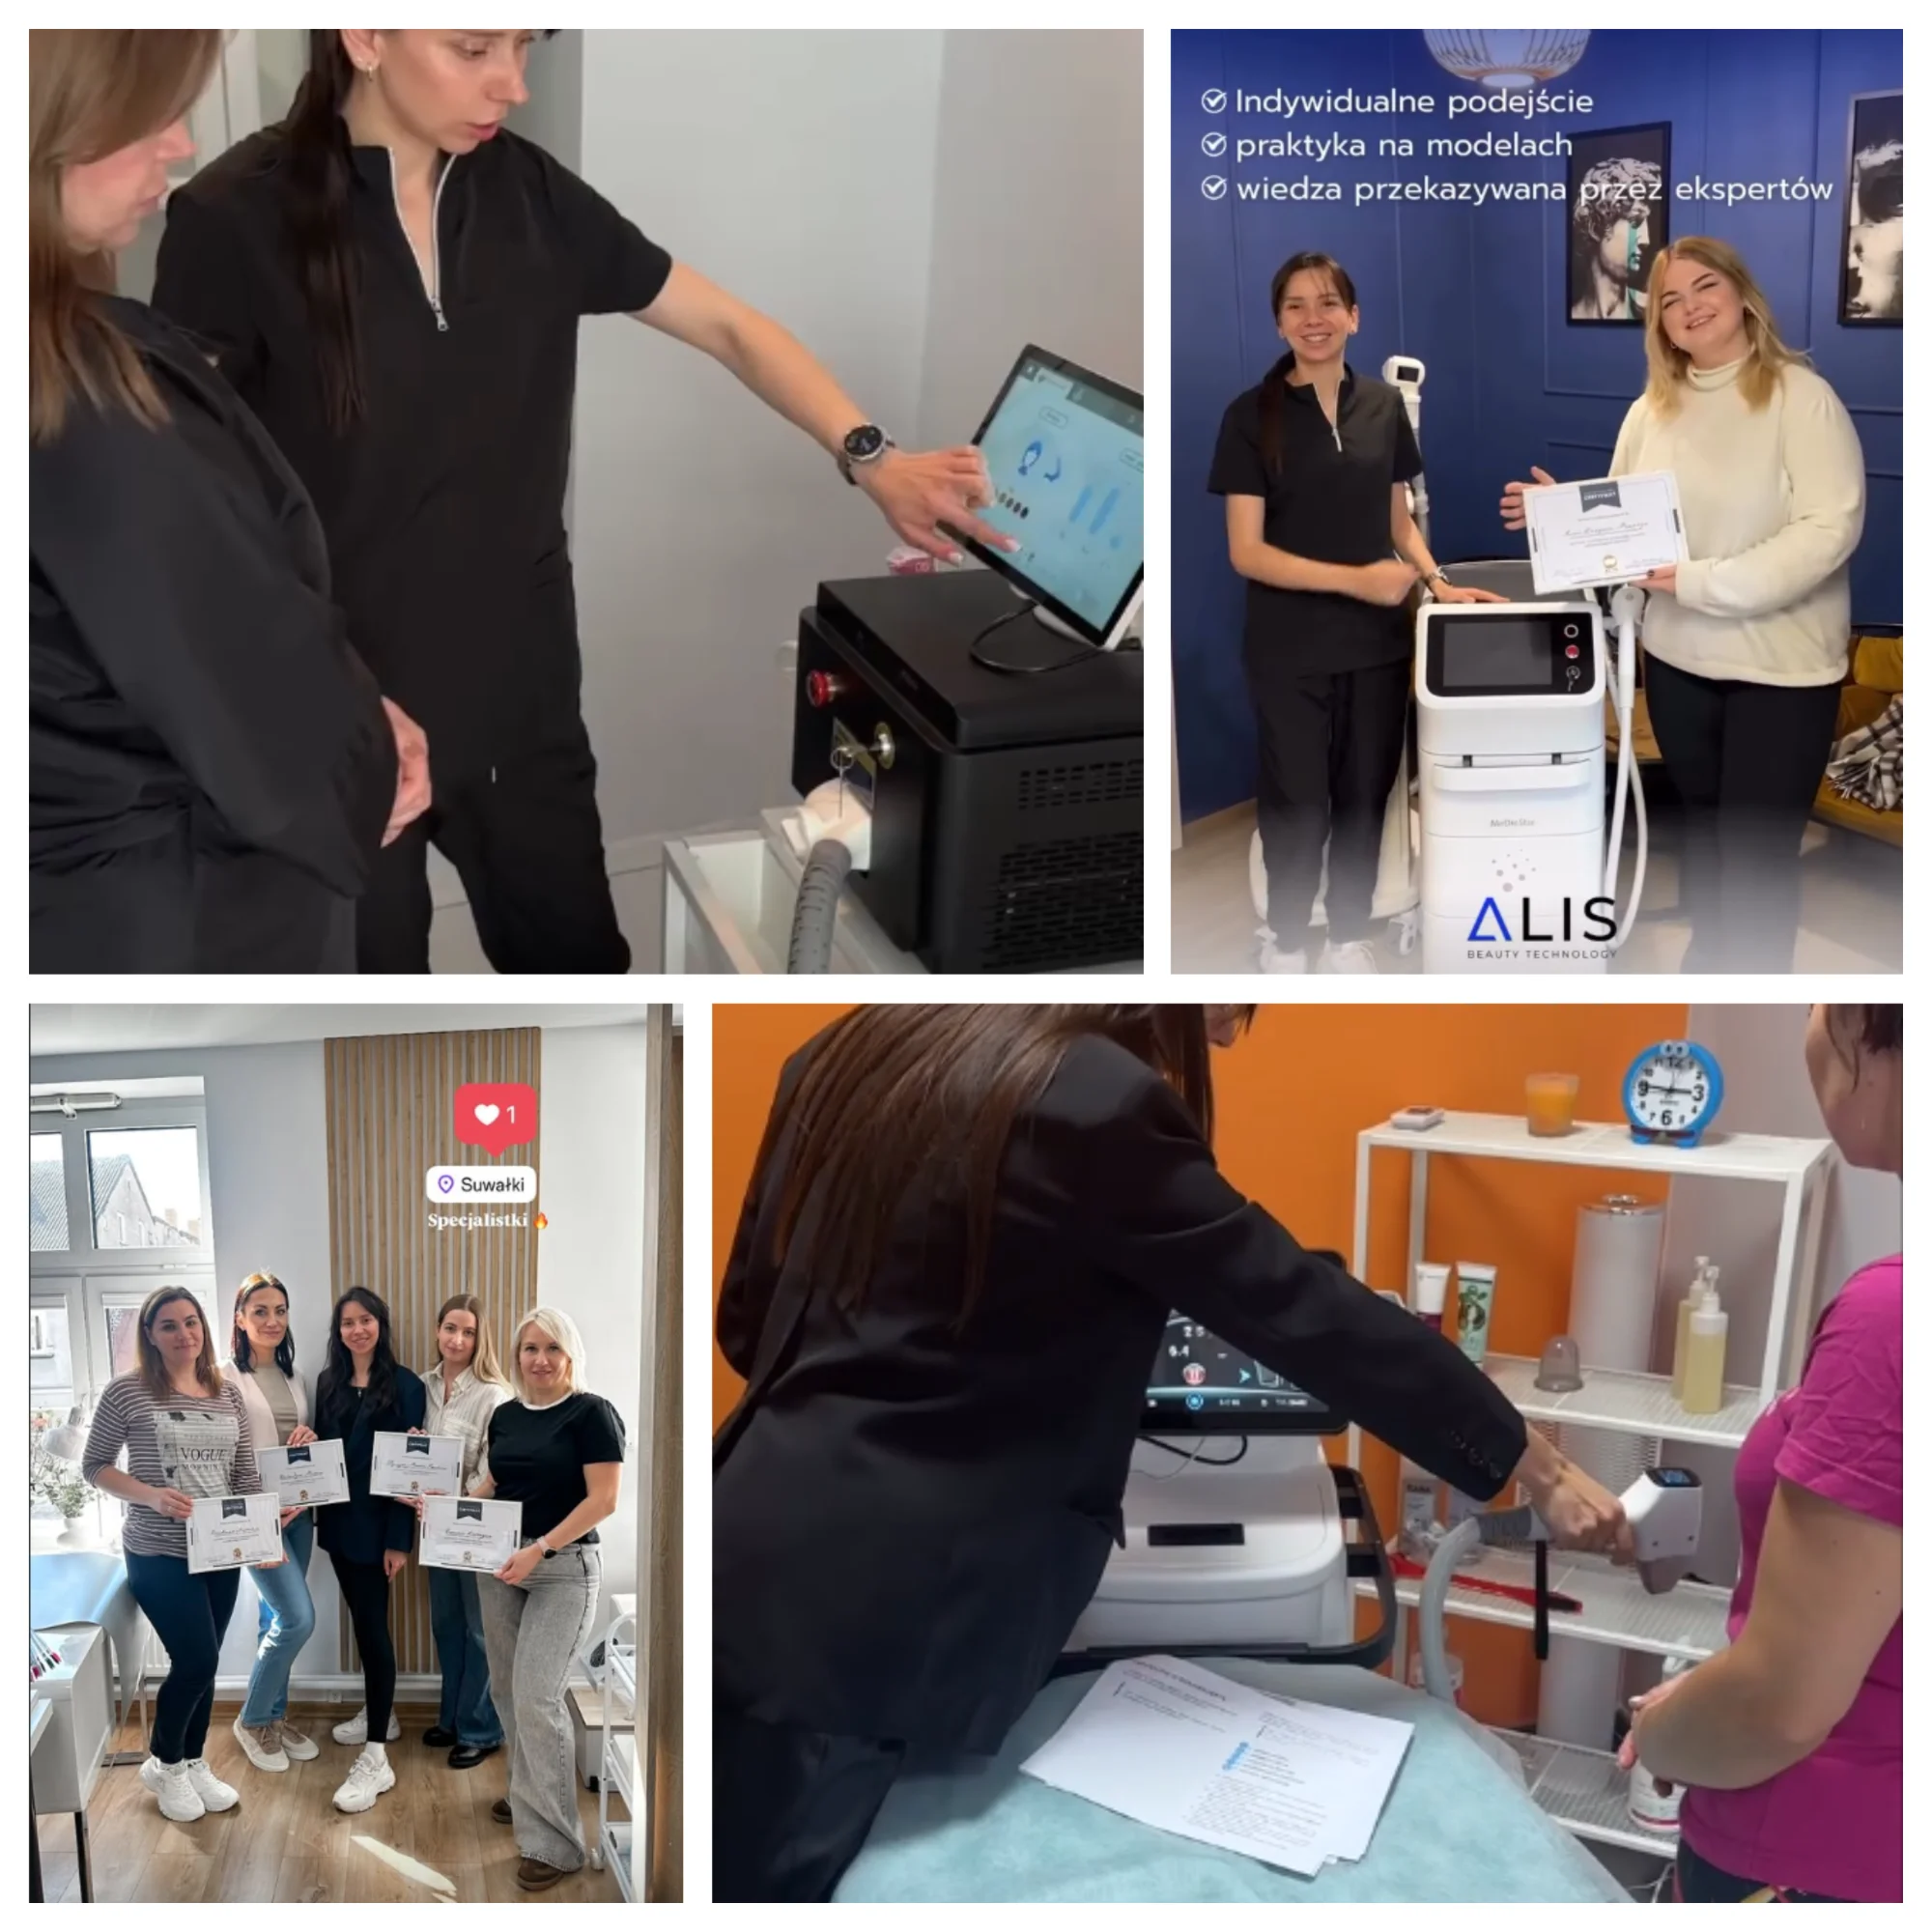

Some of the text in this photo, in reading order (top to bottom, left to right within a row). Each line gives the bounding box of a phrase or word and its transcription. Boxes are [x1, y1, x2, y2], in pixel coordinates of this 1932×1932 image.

[1692, 1084, 1704, 1102] 3
[1661, 1110, 1673, 1125] 6
[180, 1447, 228, 1462] VOGUE
